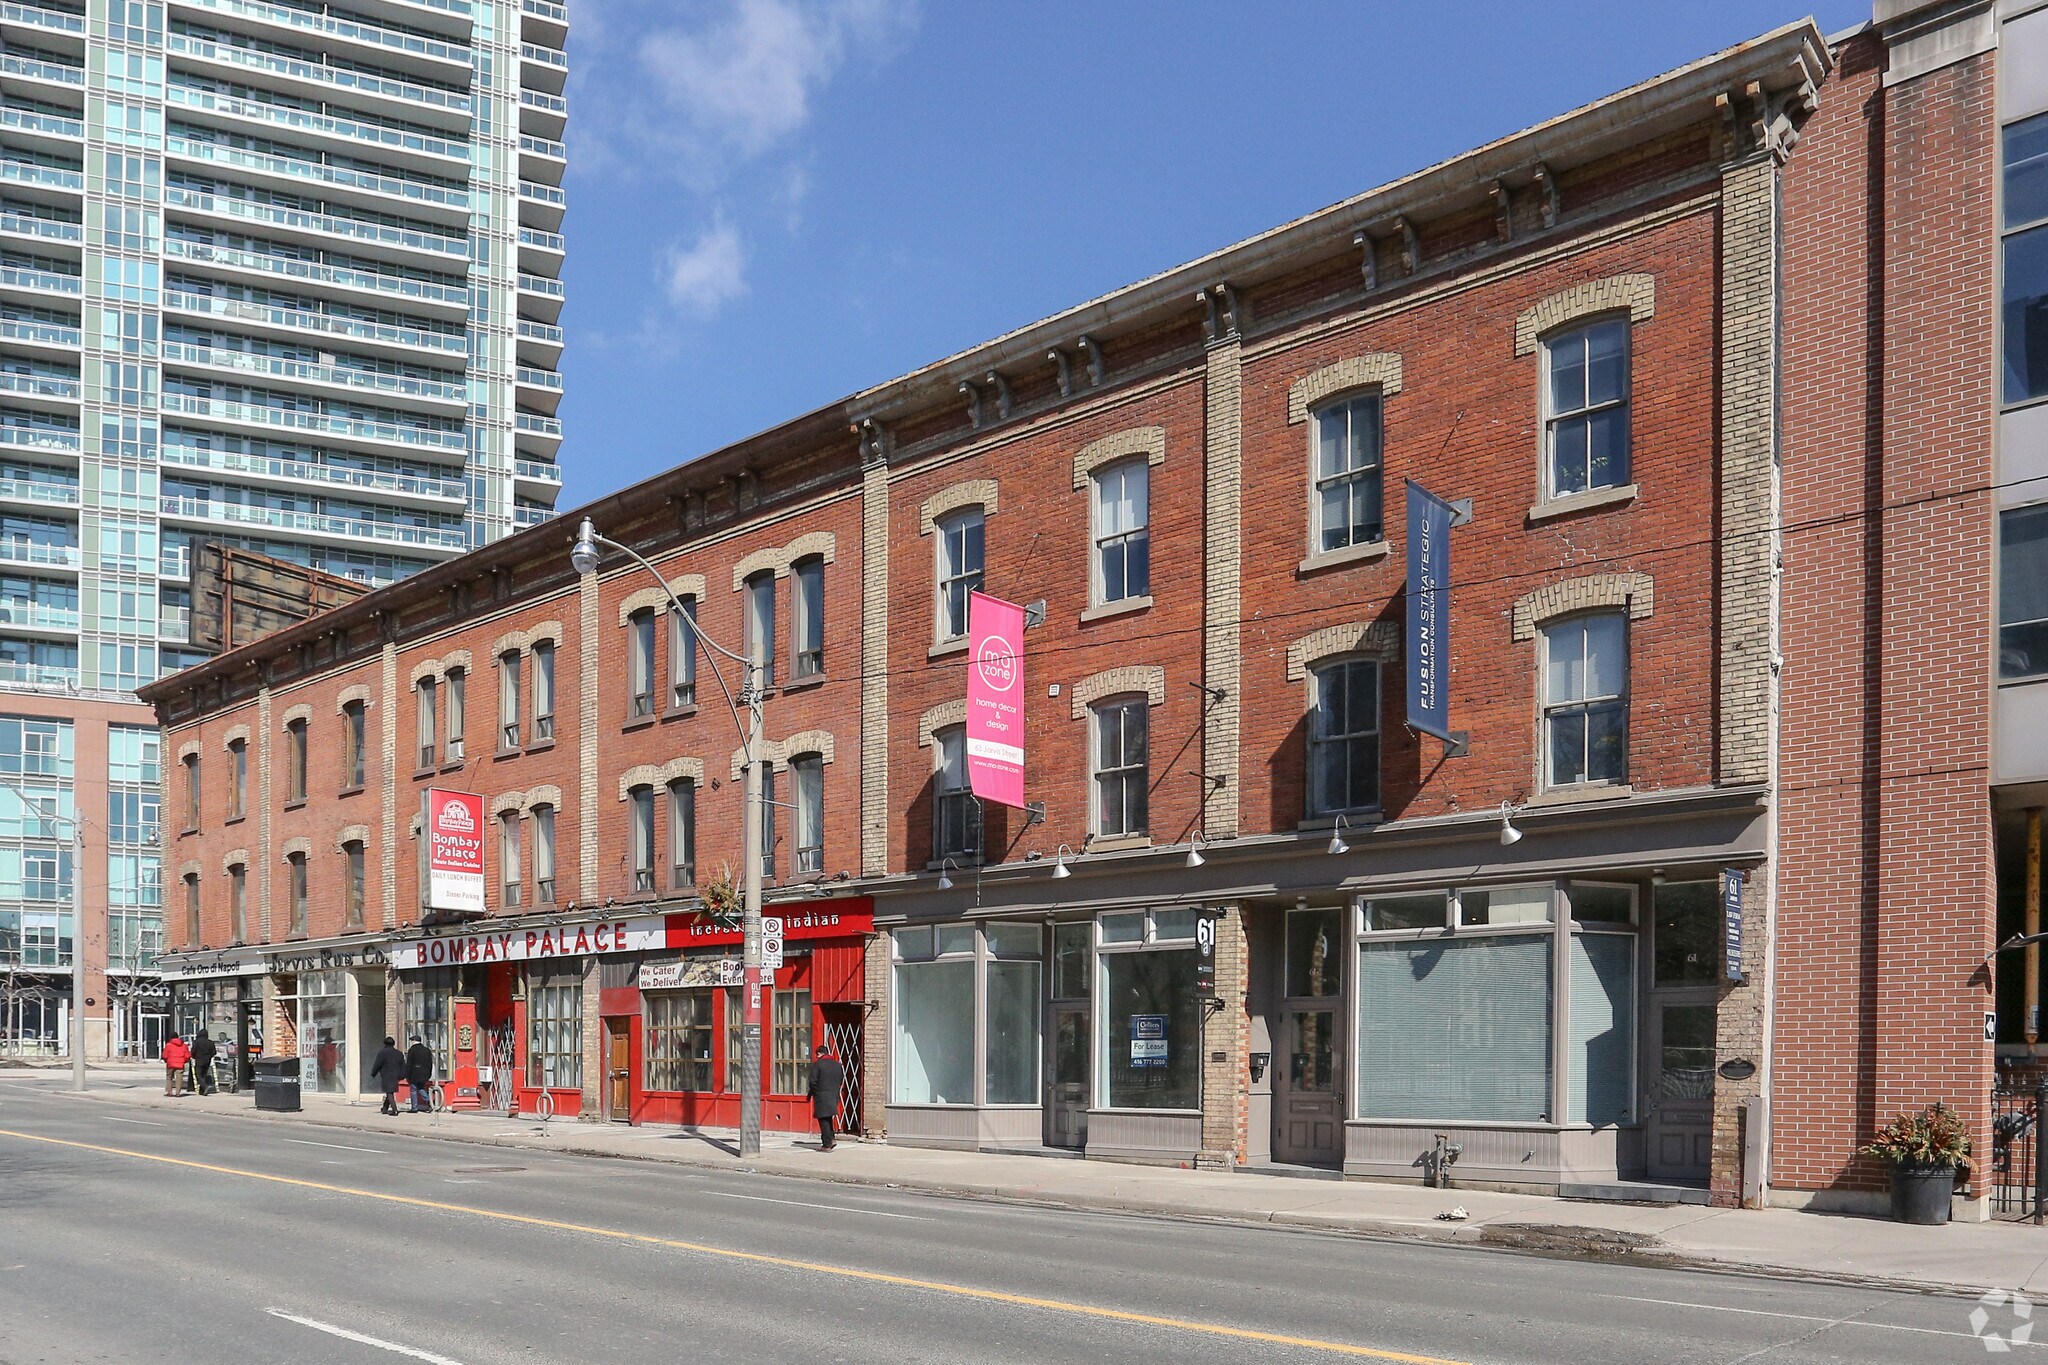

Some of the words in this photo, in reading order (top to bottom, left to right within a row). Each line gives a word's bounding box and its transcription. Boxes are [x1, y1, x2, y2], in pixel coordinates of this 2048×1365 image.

[1420, 519, 1430, 621] STRATEGIC
[985, 665, 1010, 680] zone
[1420, 626, 1429, 709] FUSION
[976, 697, 997, 709] home
[998, 702, 1017, 714] decor
[995, 711, 1001, 719] &
[986, 719, 1009, 731] design
[975, 745, 983, 753] 63
[984, 746, 1001, 756] Jarvis
[1002, 749, 1018, 759] Street
[433, 833, 480, 850] Bombay
[437, 845, 476, 859] Palace
[448, 859, 463, 867] Indian
[463, 861, 480, 869] Cuisine
[432, 871, 446, 879] DAILY
[447, 873, 463, 881] LUNCH
[464, 875, 482, 883] BUFFET
[1729, 879, 1738, 895] 61
[462, 892, 479, 901] Parking
[786, 911, 839, 929] indian
[1197, 918, 1215, 946] 61
[416, 933, 512, 967] BOMBAY
[526, 922, 628, 958] PALACE
[1203, 942, 1209, 954] a
[1688, 953, 1697, 962] 61
[197, 964, 209, 974] Oro
[210, 963, 217, 973] di
[218, 961, 240, 974] Napoli
[640, 968, 651, 976] We
[652, 966, 676, 976] Cater
[640, 980, 651, 988] We
[652, 977, 682, 987] Deliver
[760, 974, 773, 983] ere
[1133, 1042, 1145, 1050] For
[1146, 1042, 1164, 1050] Lease
